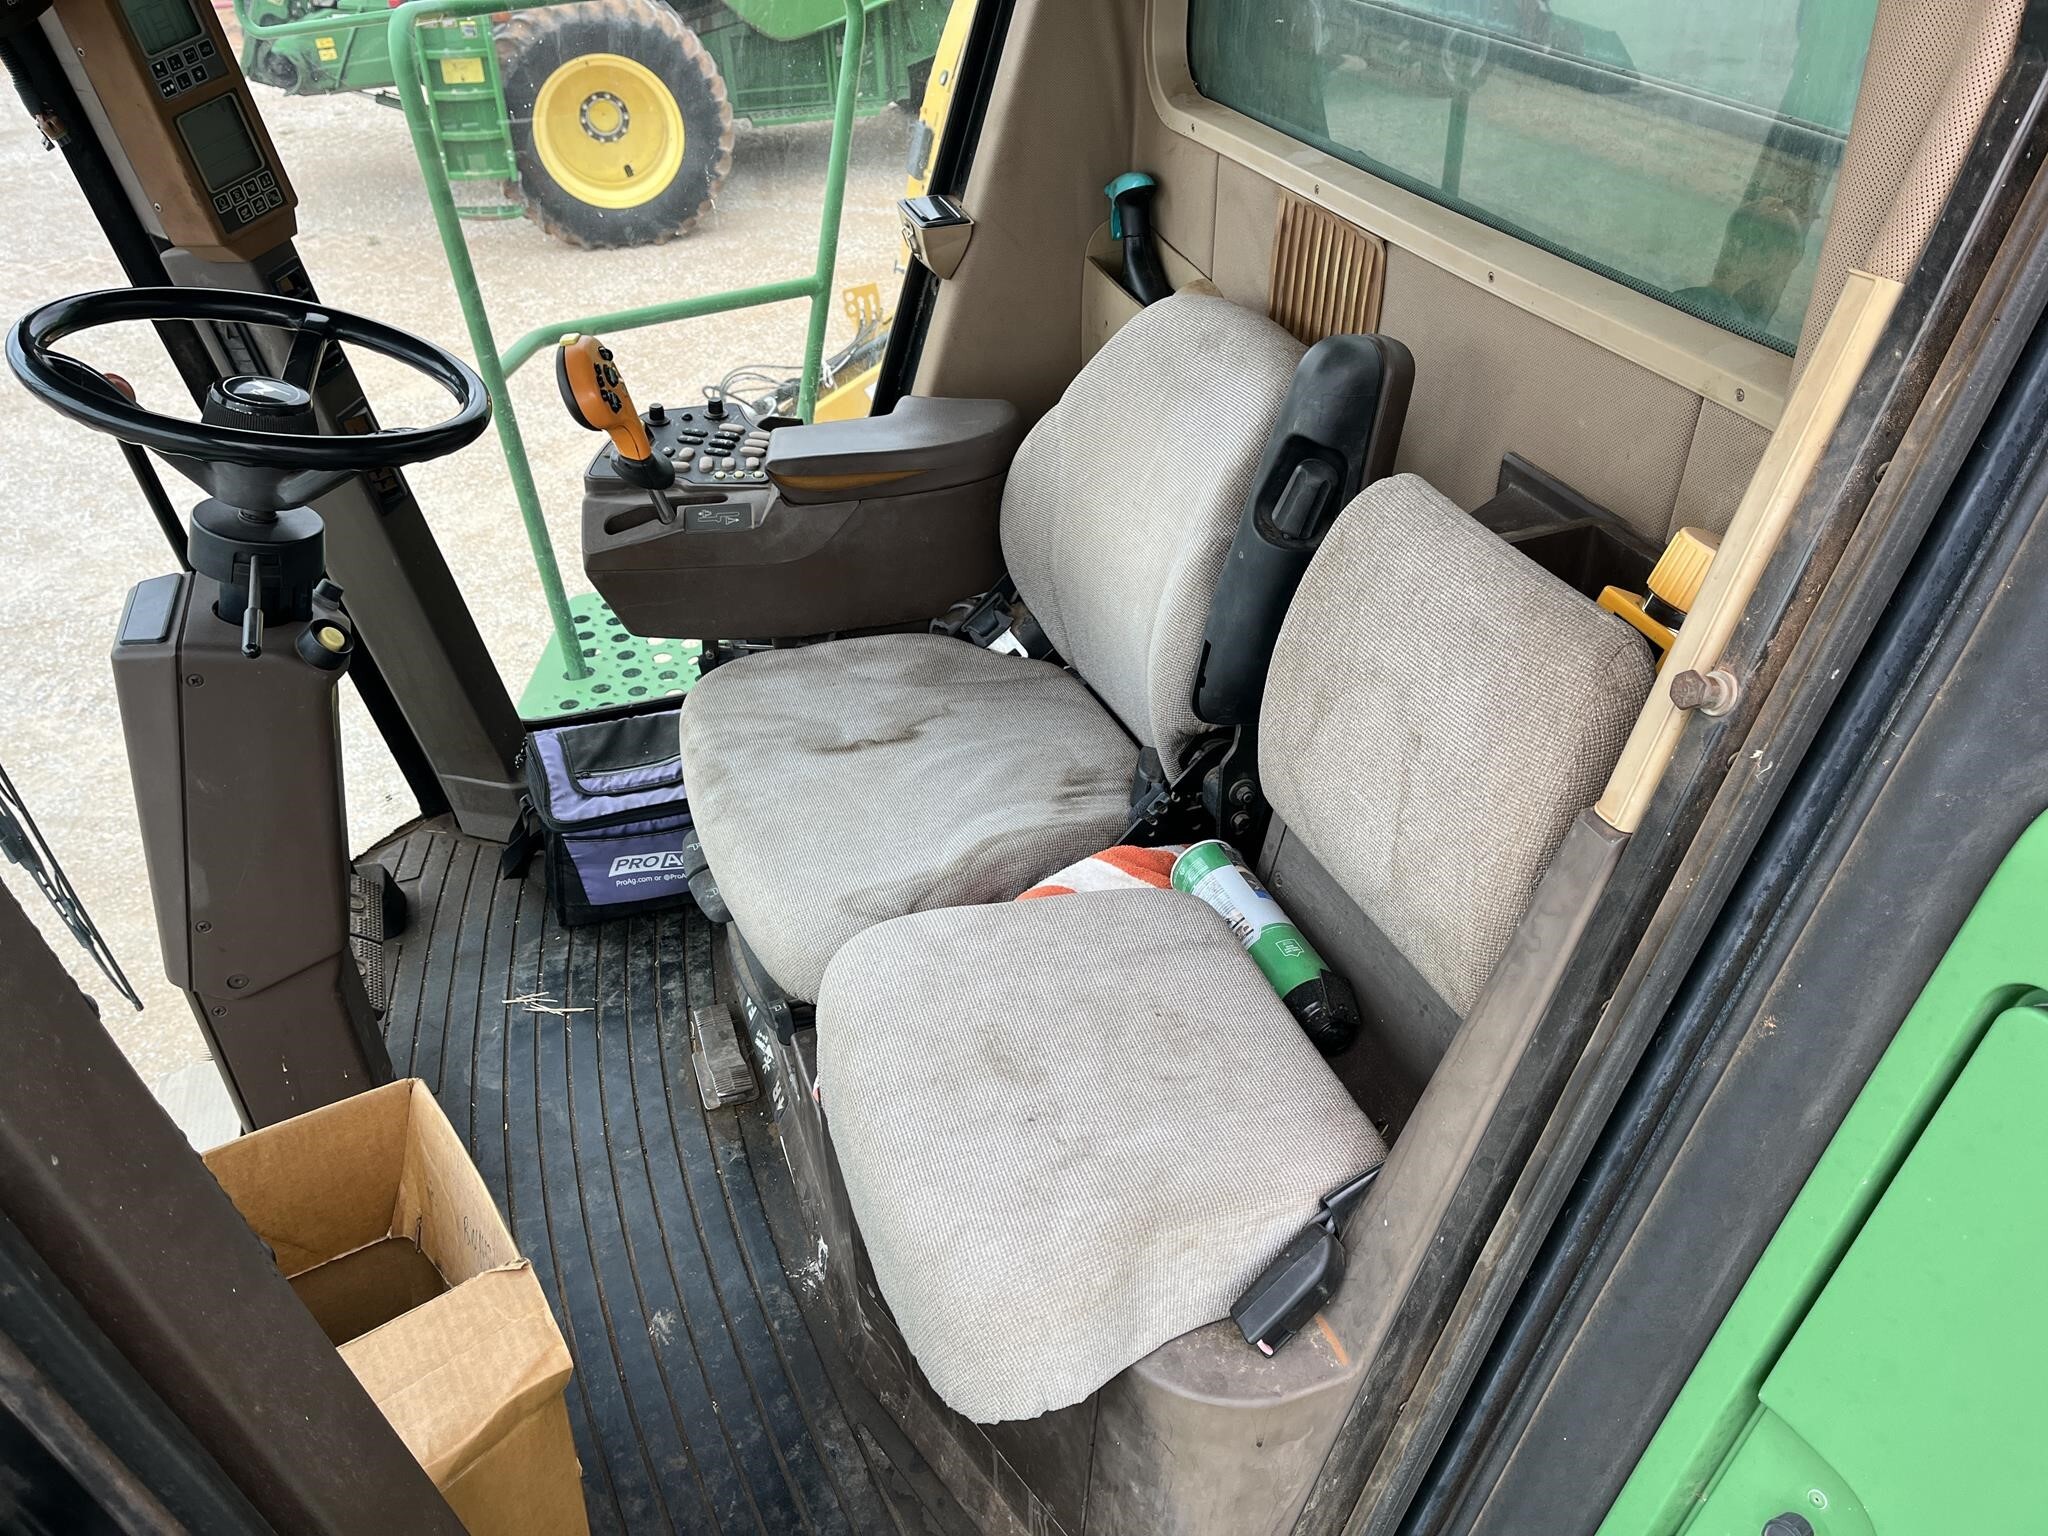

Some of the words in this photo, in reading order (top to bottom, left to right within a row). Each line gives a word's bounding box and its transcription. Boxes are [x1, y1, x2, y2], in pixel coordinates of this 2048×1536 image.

[614, 853, 684, 872] PROA
[615, 876, 653, 888] ProAg.com
[663, 873, 687, 881] @ProA
